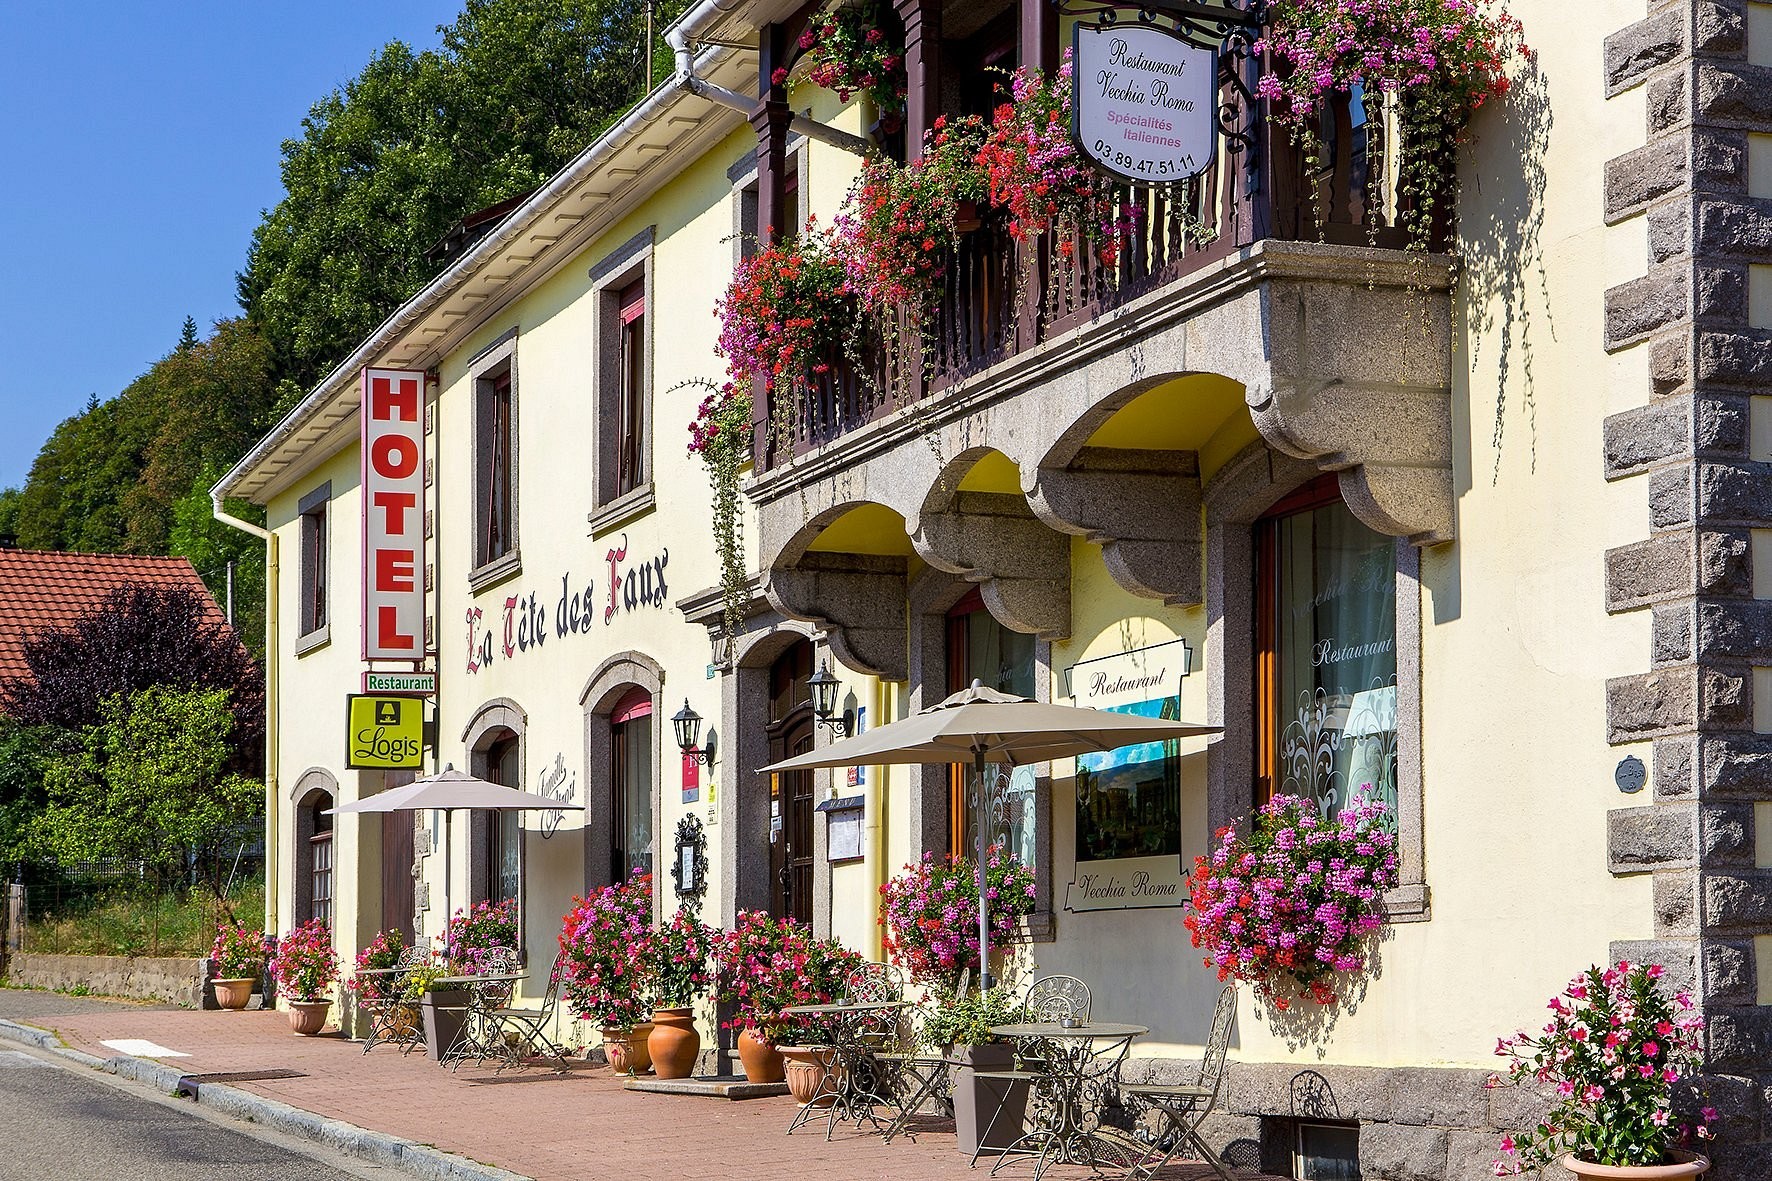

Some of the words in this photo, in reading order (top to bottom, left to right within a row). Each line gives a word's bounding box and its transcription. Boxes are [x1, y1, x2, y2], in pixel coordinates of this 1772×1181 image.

[1109, 37, 1186, 77] Restaurant
[1096, 70, 1145, 105] Vecchia
[1150, 78, 1194, 113] Roma
[1107, 110, 1173, 131] Spécialités
[1124, 128, 1181, 148] Italiennes
[1094, 139, 1196, 174] 03.89.47.51.11
[371, 377, 418, 650] HOTEL
[466, 606, 493, 675] La
[502, 590, 546, 660] Tête
[556, 571, 593, 639] des
[604, 533, 669, 626] Faux
[1311, 633, 1393, 667] Restaurant
[368, 675, 434, 690] Restaurant
[1089, 667, 1166, 697] Restaurant
[354, 726, 419, 763] Logis
[1079, 874, 1127, 899] Vecchia
[1131, 870, 1177, 896] Roma
